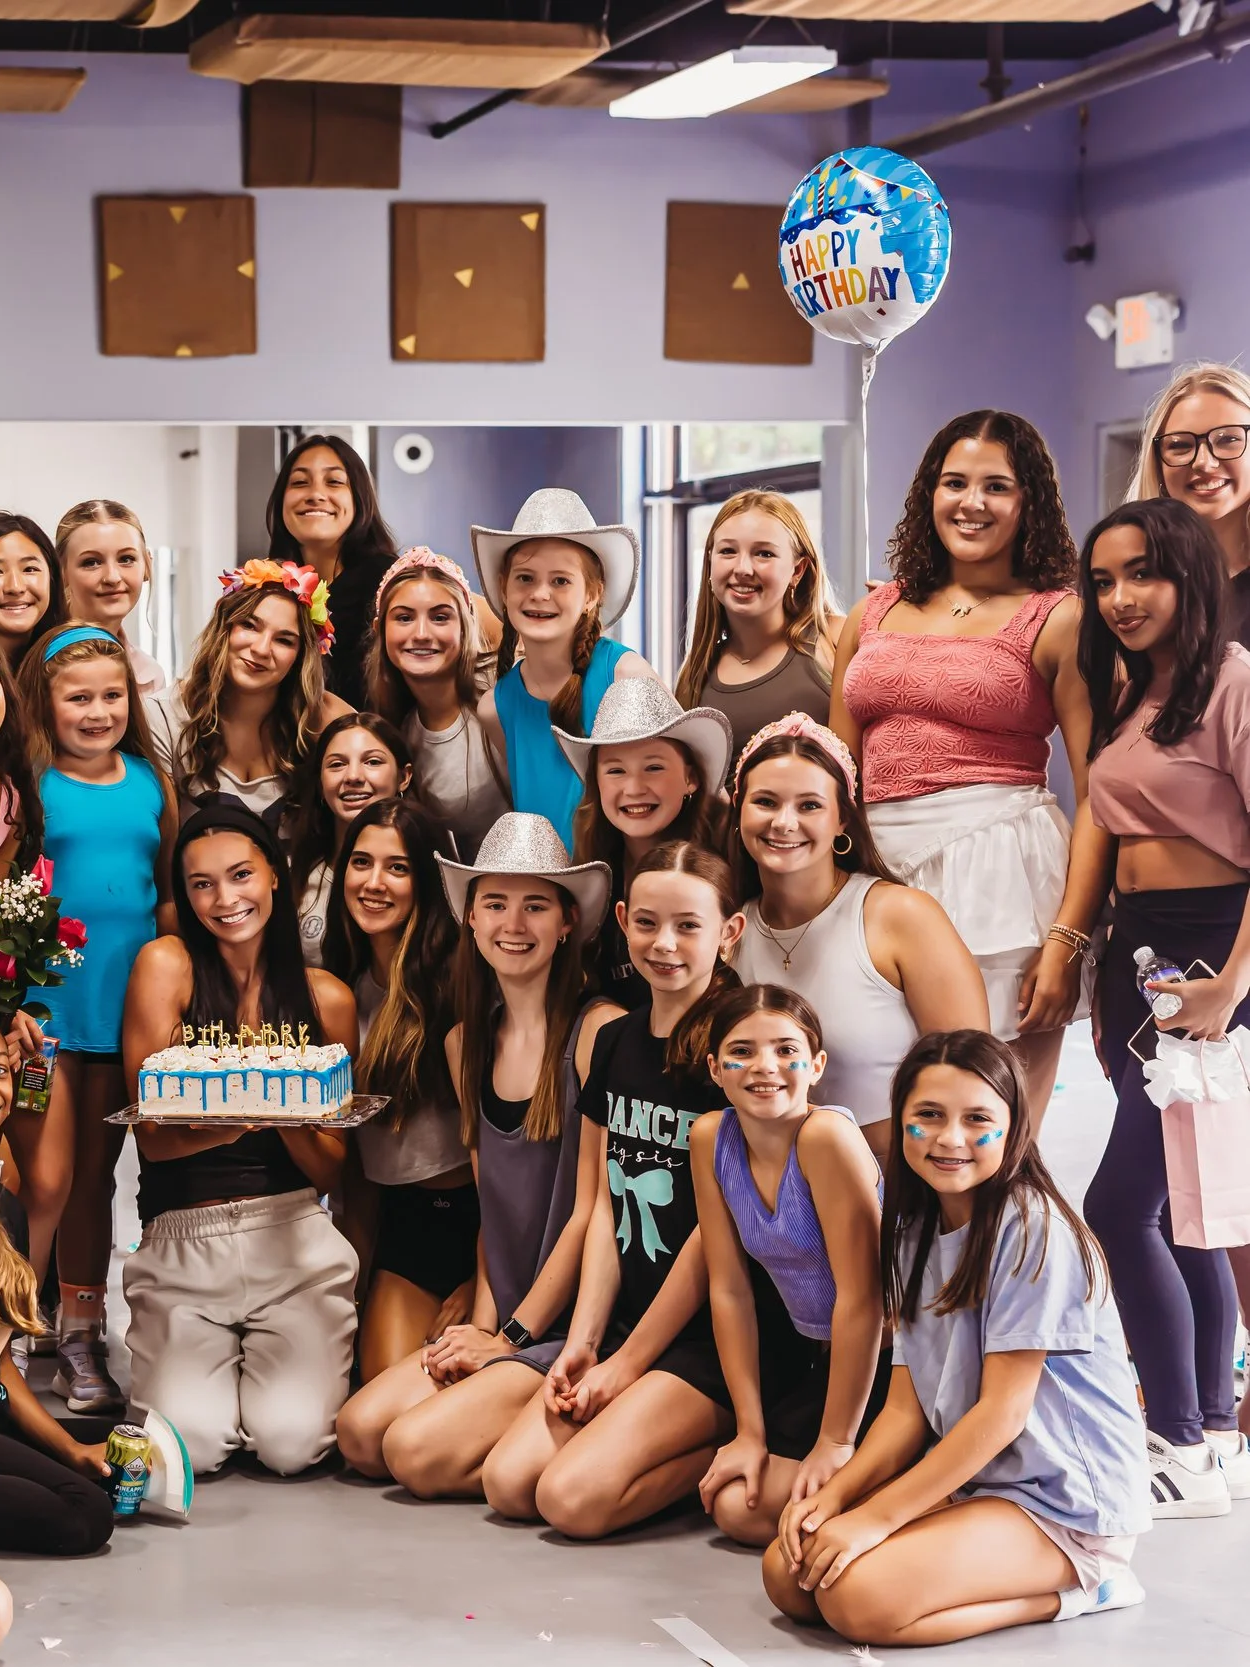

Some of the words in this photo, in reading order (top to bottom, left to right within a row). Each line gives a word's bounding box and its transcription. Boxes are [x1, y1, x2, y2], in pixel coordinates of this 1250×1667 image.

[790, 228, 860, 281] HAPPY
[607, 1141, 632, 1165] ig
[636, 1151, 684, 1168] sis
